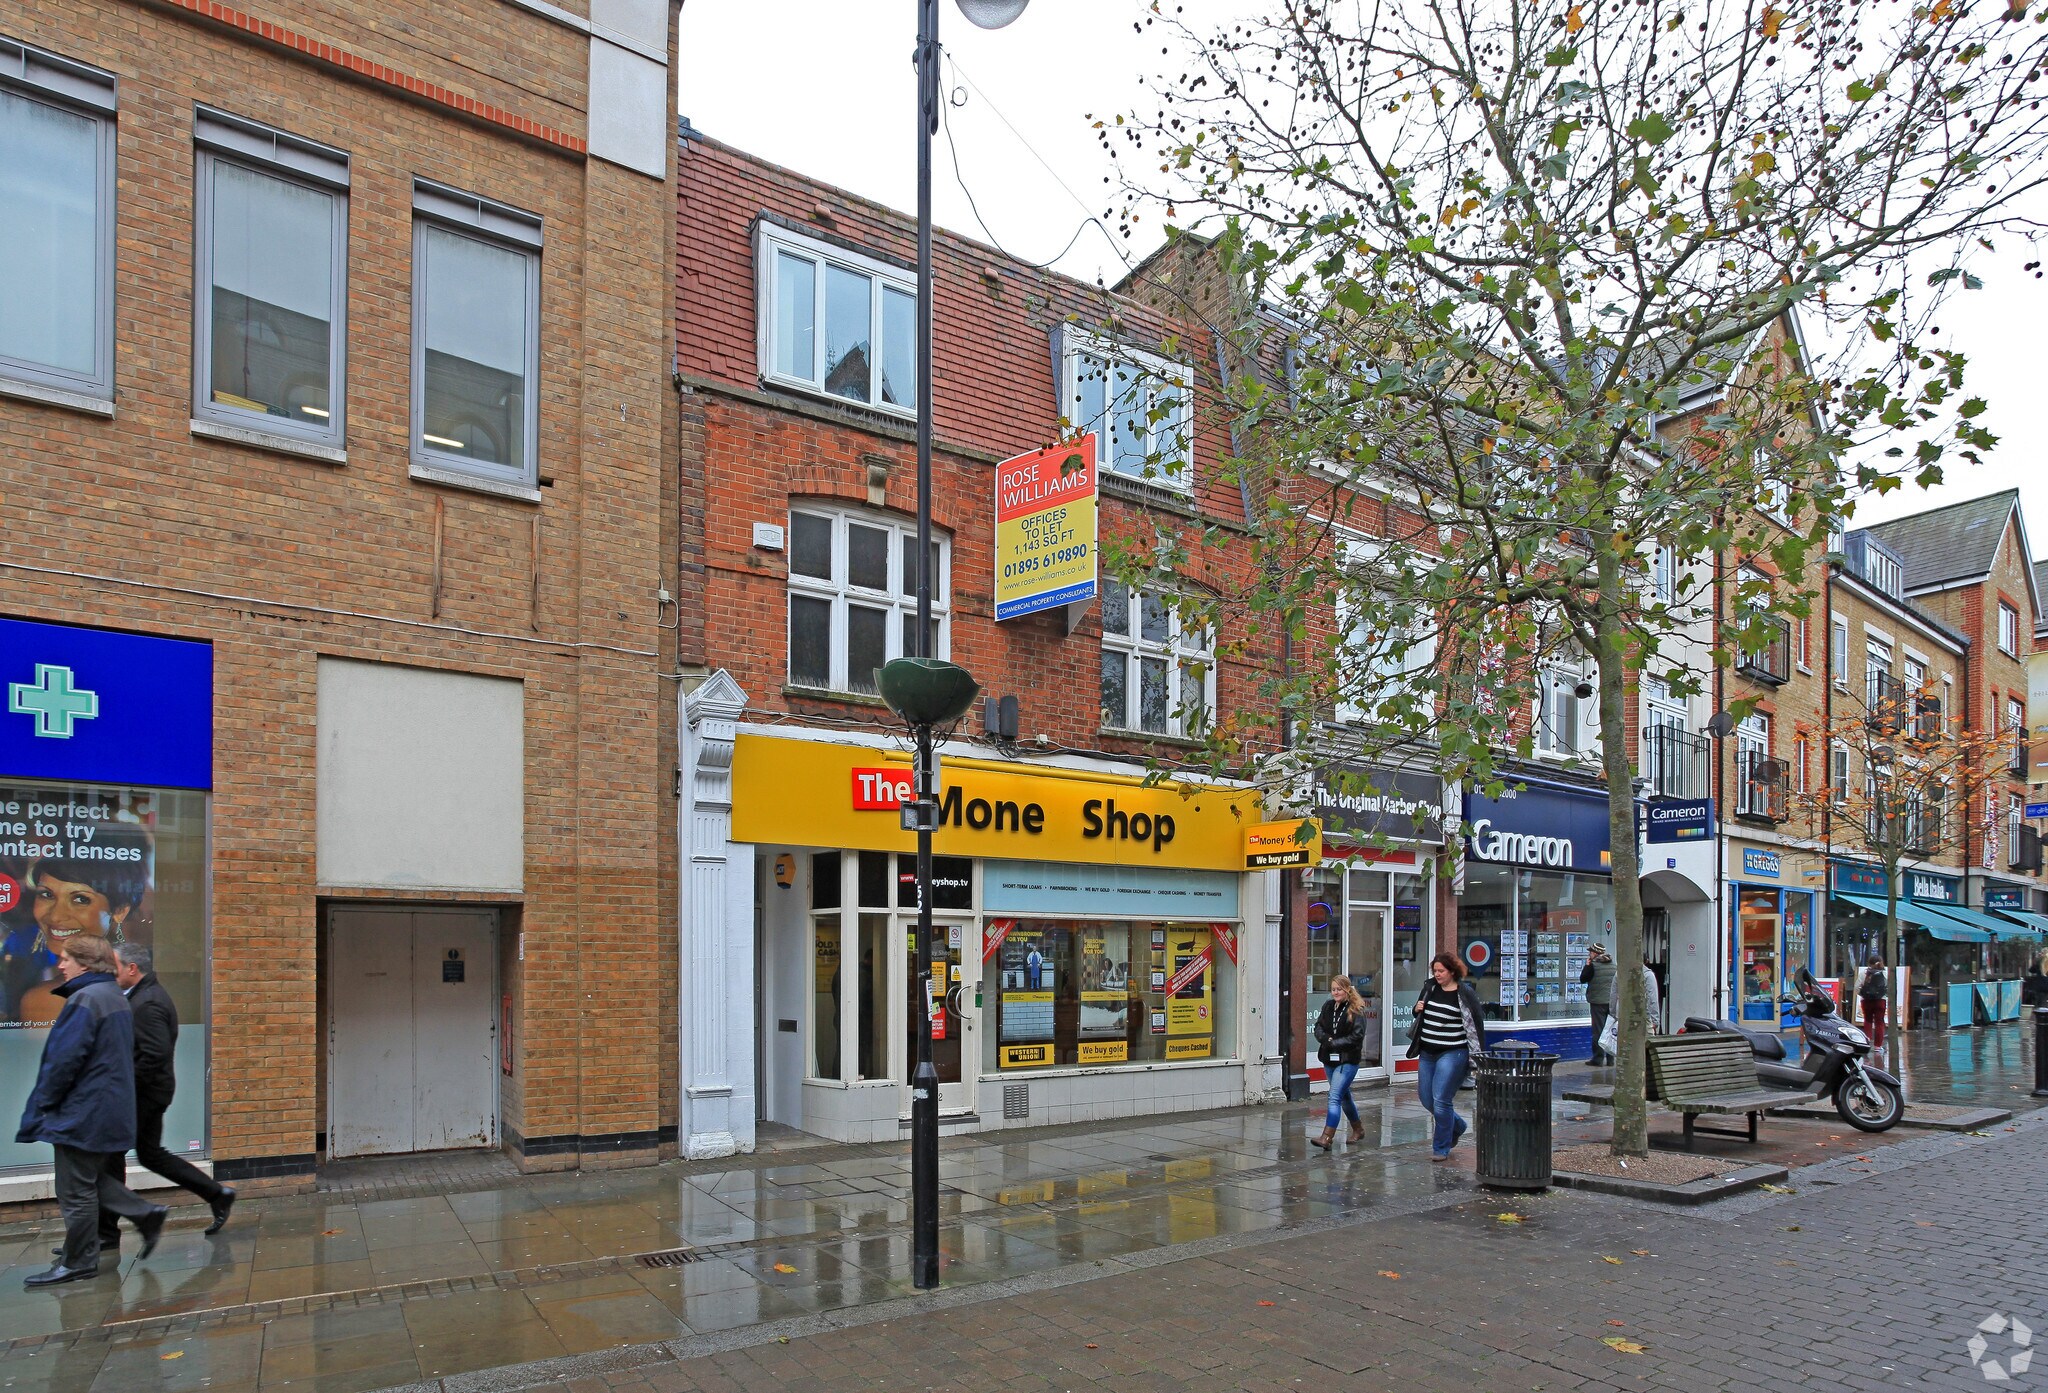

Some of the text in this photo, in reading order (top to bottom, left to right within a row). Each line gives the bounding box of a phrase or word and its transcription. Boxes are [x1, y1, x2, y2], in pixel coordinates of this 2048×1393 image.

[1003, 464, 1040, 491] ROSE
[1003, 468, 1088, 508] WILLIAMS
[1021, 508, 1067, 530] OFFICES
[1025, 521, 1062, 540] TO LET
[1015, 529, 1074, 556] 1,143 SQ FT
[1004, 544, 1087, 578] 01895 619890
[998, 586, 1093, 615] COMMERCIAL PROPERTY CONSULTANTS
[28, 801, 110, 820] perfect
[858, 773, 911, 803] The
[1083, 799, 1176, 853] Shop
[1383, 796, 1417, 816] Barber
[1652, 807, 1705, 819] Cameron
[35, 820, 58, 838] to
[66, 821, 95, 843] try
[1260, 837, 1285, 846] Money
[70, 841, 142, 862] lenses
[1472, 819, 1573, 867] Cameron
[1256, 853, 1300, 865] We buy gold
[1913, 875, 1946, 900] Bella Italia
[1393, 1005, 1405, 1015] The
[1393, 1018, 1412, 1029] Barber
[1815, 1029, 1840, 1039] YAMAHA
[1009, 1048, 1040, 1056] WESTERN
[1082, 1045, 1124, 1055] We buy gold
[1168, 1043, 1209, 1054] Cheques Cashed
